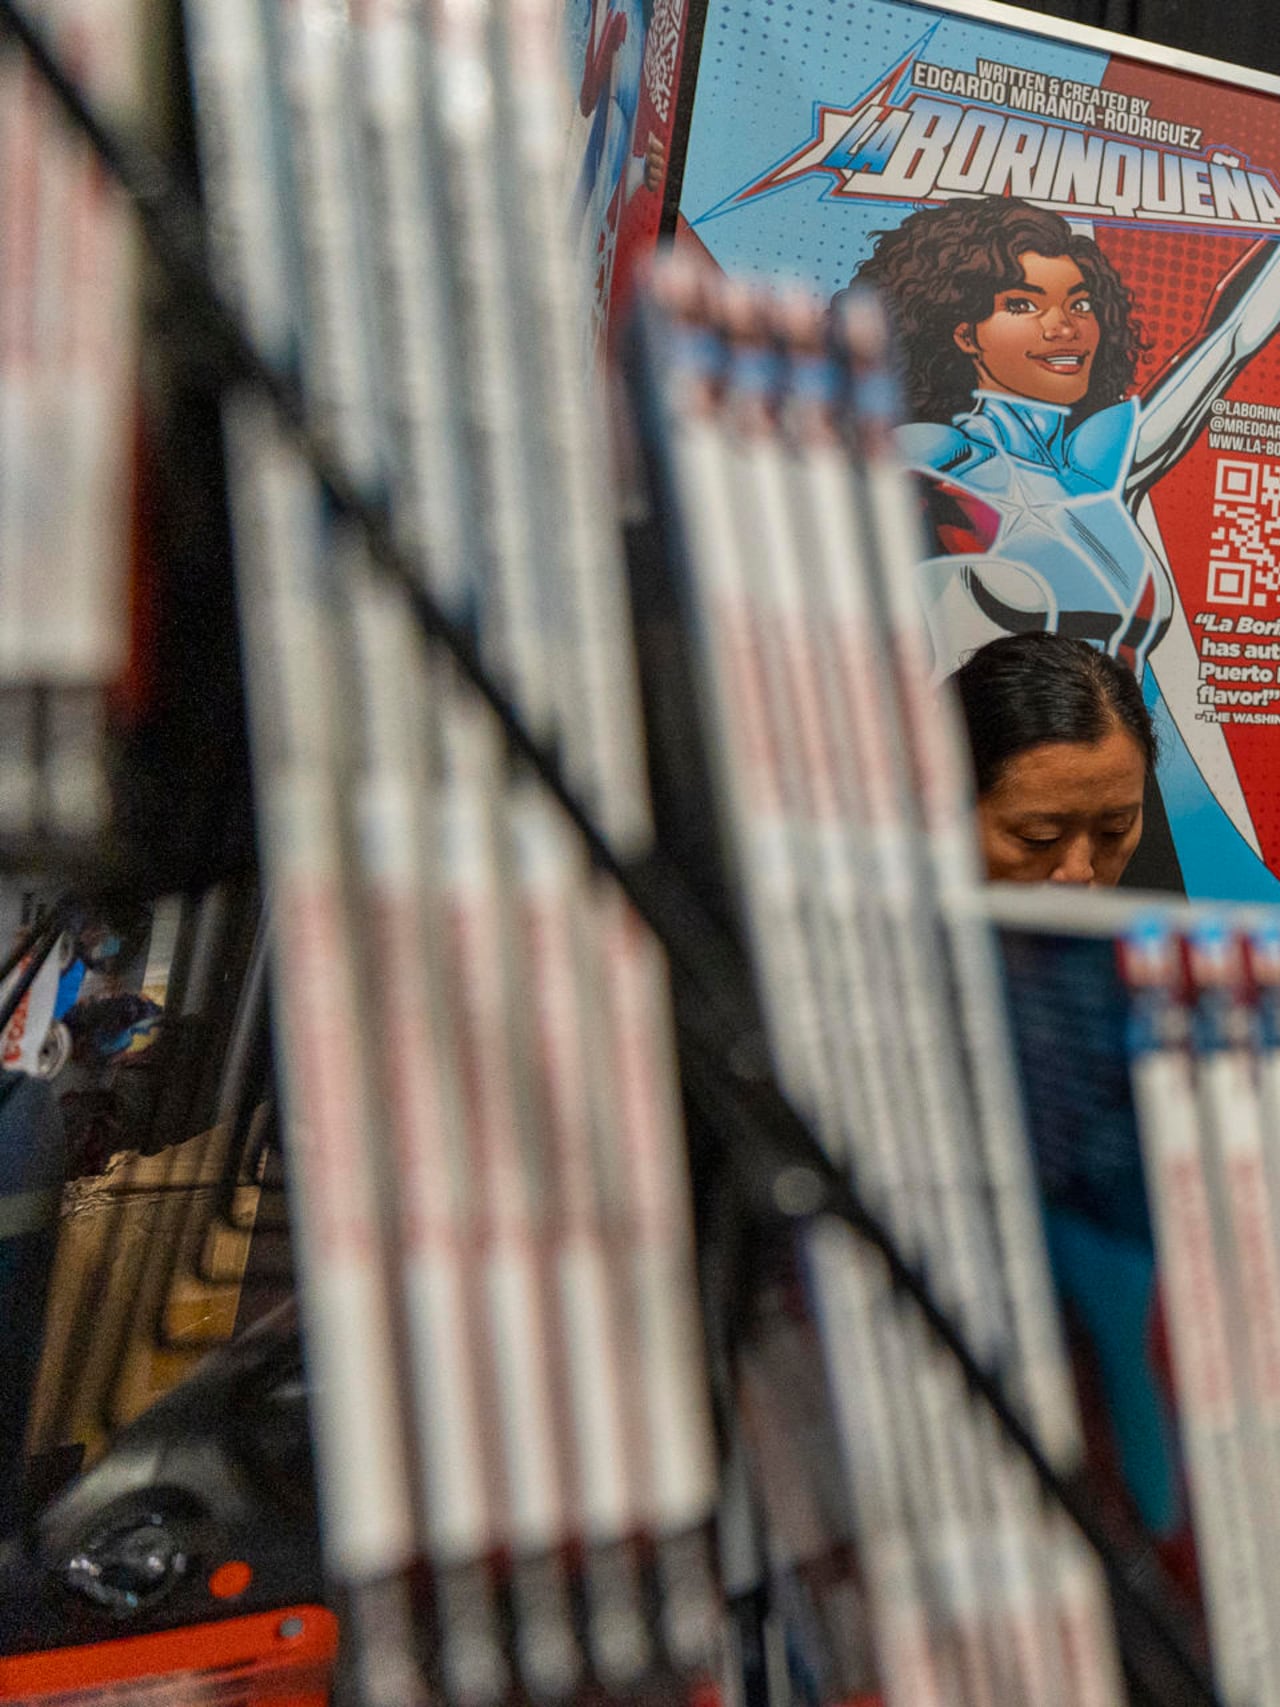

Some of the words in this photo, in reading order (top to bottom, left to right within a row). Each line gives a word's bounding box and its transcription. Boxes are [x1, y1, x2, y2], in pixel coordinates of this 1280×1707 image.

[977, 59, 1050, 91] WRITTEN
[1049, 78, 1061, 97] &
[1062, 80, 1128, 112] CREATED
[1130, 97, 1151, 116] BY
[912, 61, 1006, 105] EDGARDO
[1009, 88, 1202, 150] MIRANDA-RODRIGUEZ
[823, 105, 900, 173] LA
[1195, 613, 1233, 633] “La
[1201, 638, 1241, 658] has
[1199, 662, 1273, 683] Puerto
[1197, 685, 1280, 706] flavor!”
